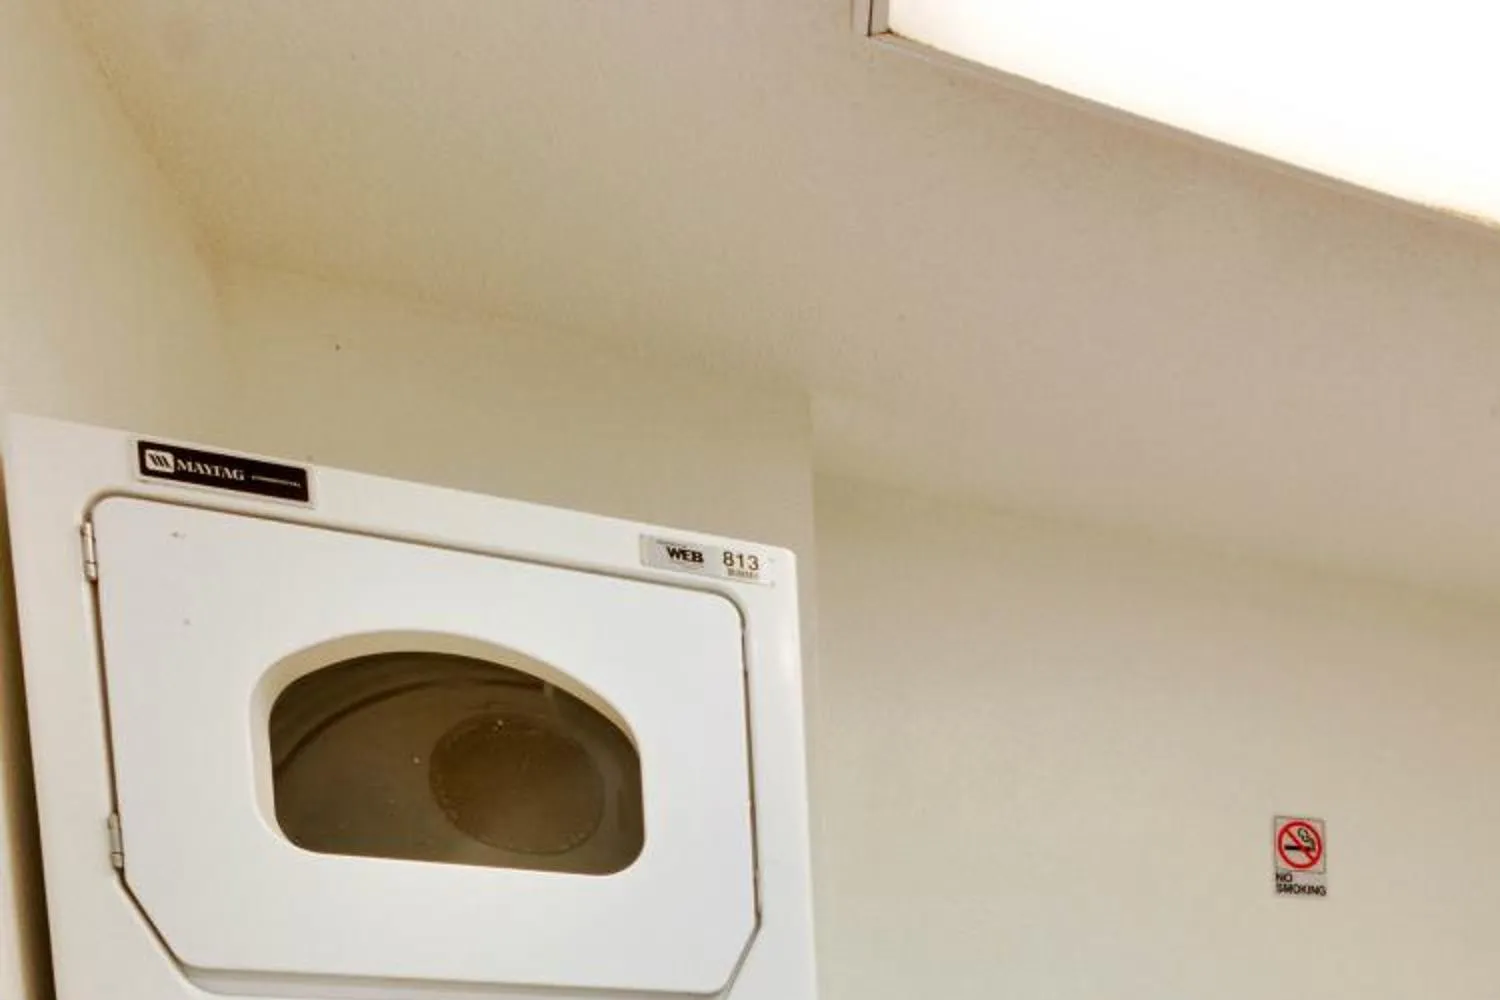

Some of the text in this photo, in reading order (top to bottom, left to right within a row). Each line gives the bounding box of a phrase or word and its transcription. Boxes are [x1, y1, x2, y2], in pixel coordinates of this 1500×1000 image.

[176, 459, 245, 481] MAYTAG
[666, 546, 759, 571] WEB 813
[1276, 872, 1293, 882] NO
[1276, 883, 1327, 896] SMOKING
